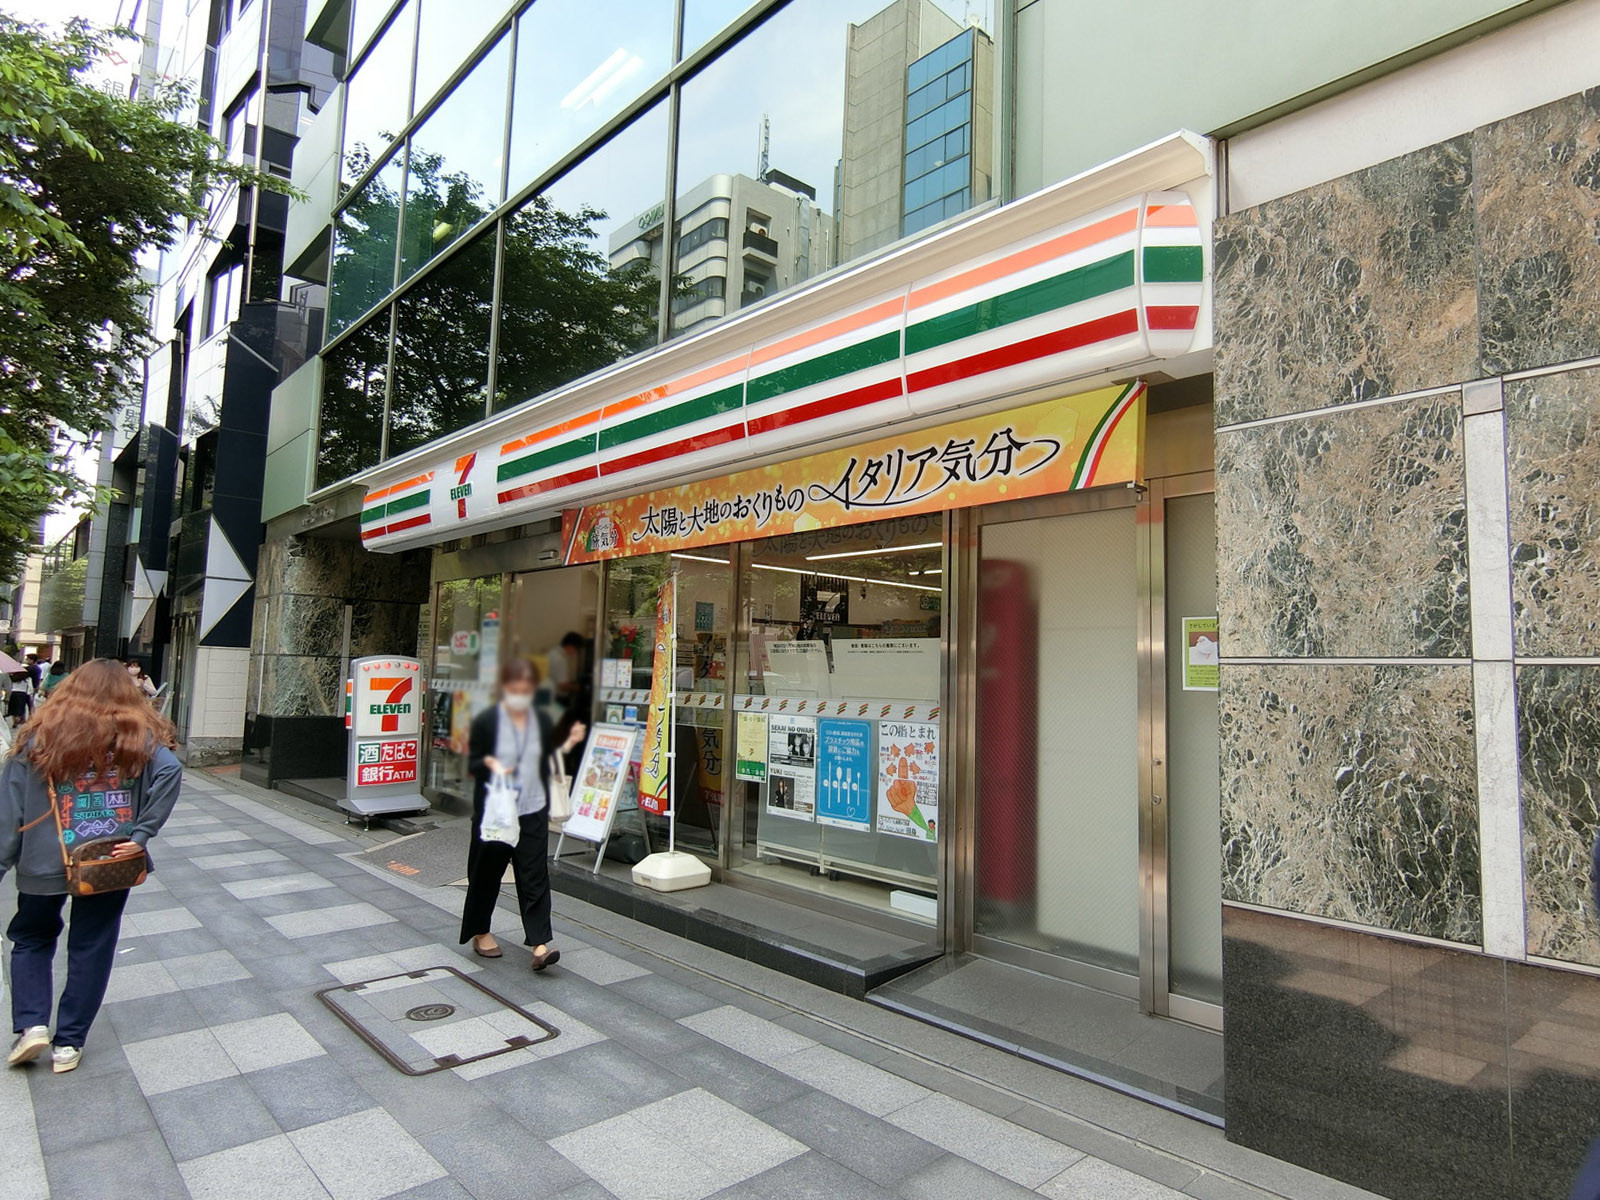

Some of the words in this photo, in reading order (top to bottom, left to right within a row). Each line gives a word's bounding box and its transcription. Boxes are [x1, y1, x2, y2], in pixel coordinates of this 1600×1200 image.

[632, 484, 805, 542] 太陽と大地のおくりもの
[806, 427, 1060, 510] イタリア気分
[881, 724, 937, 740] この指とまれ
[360, 744, 380, 764] 酒
[382, 742, 416, 761] たばこ
